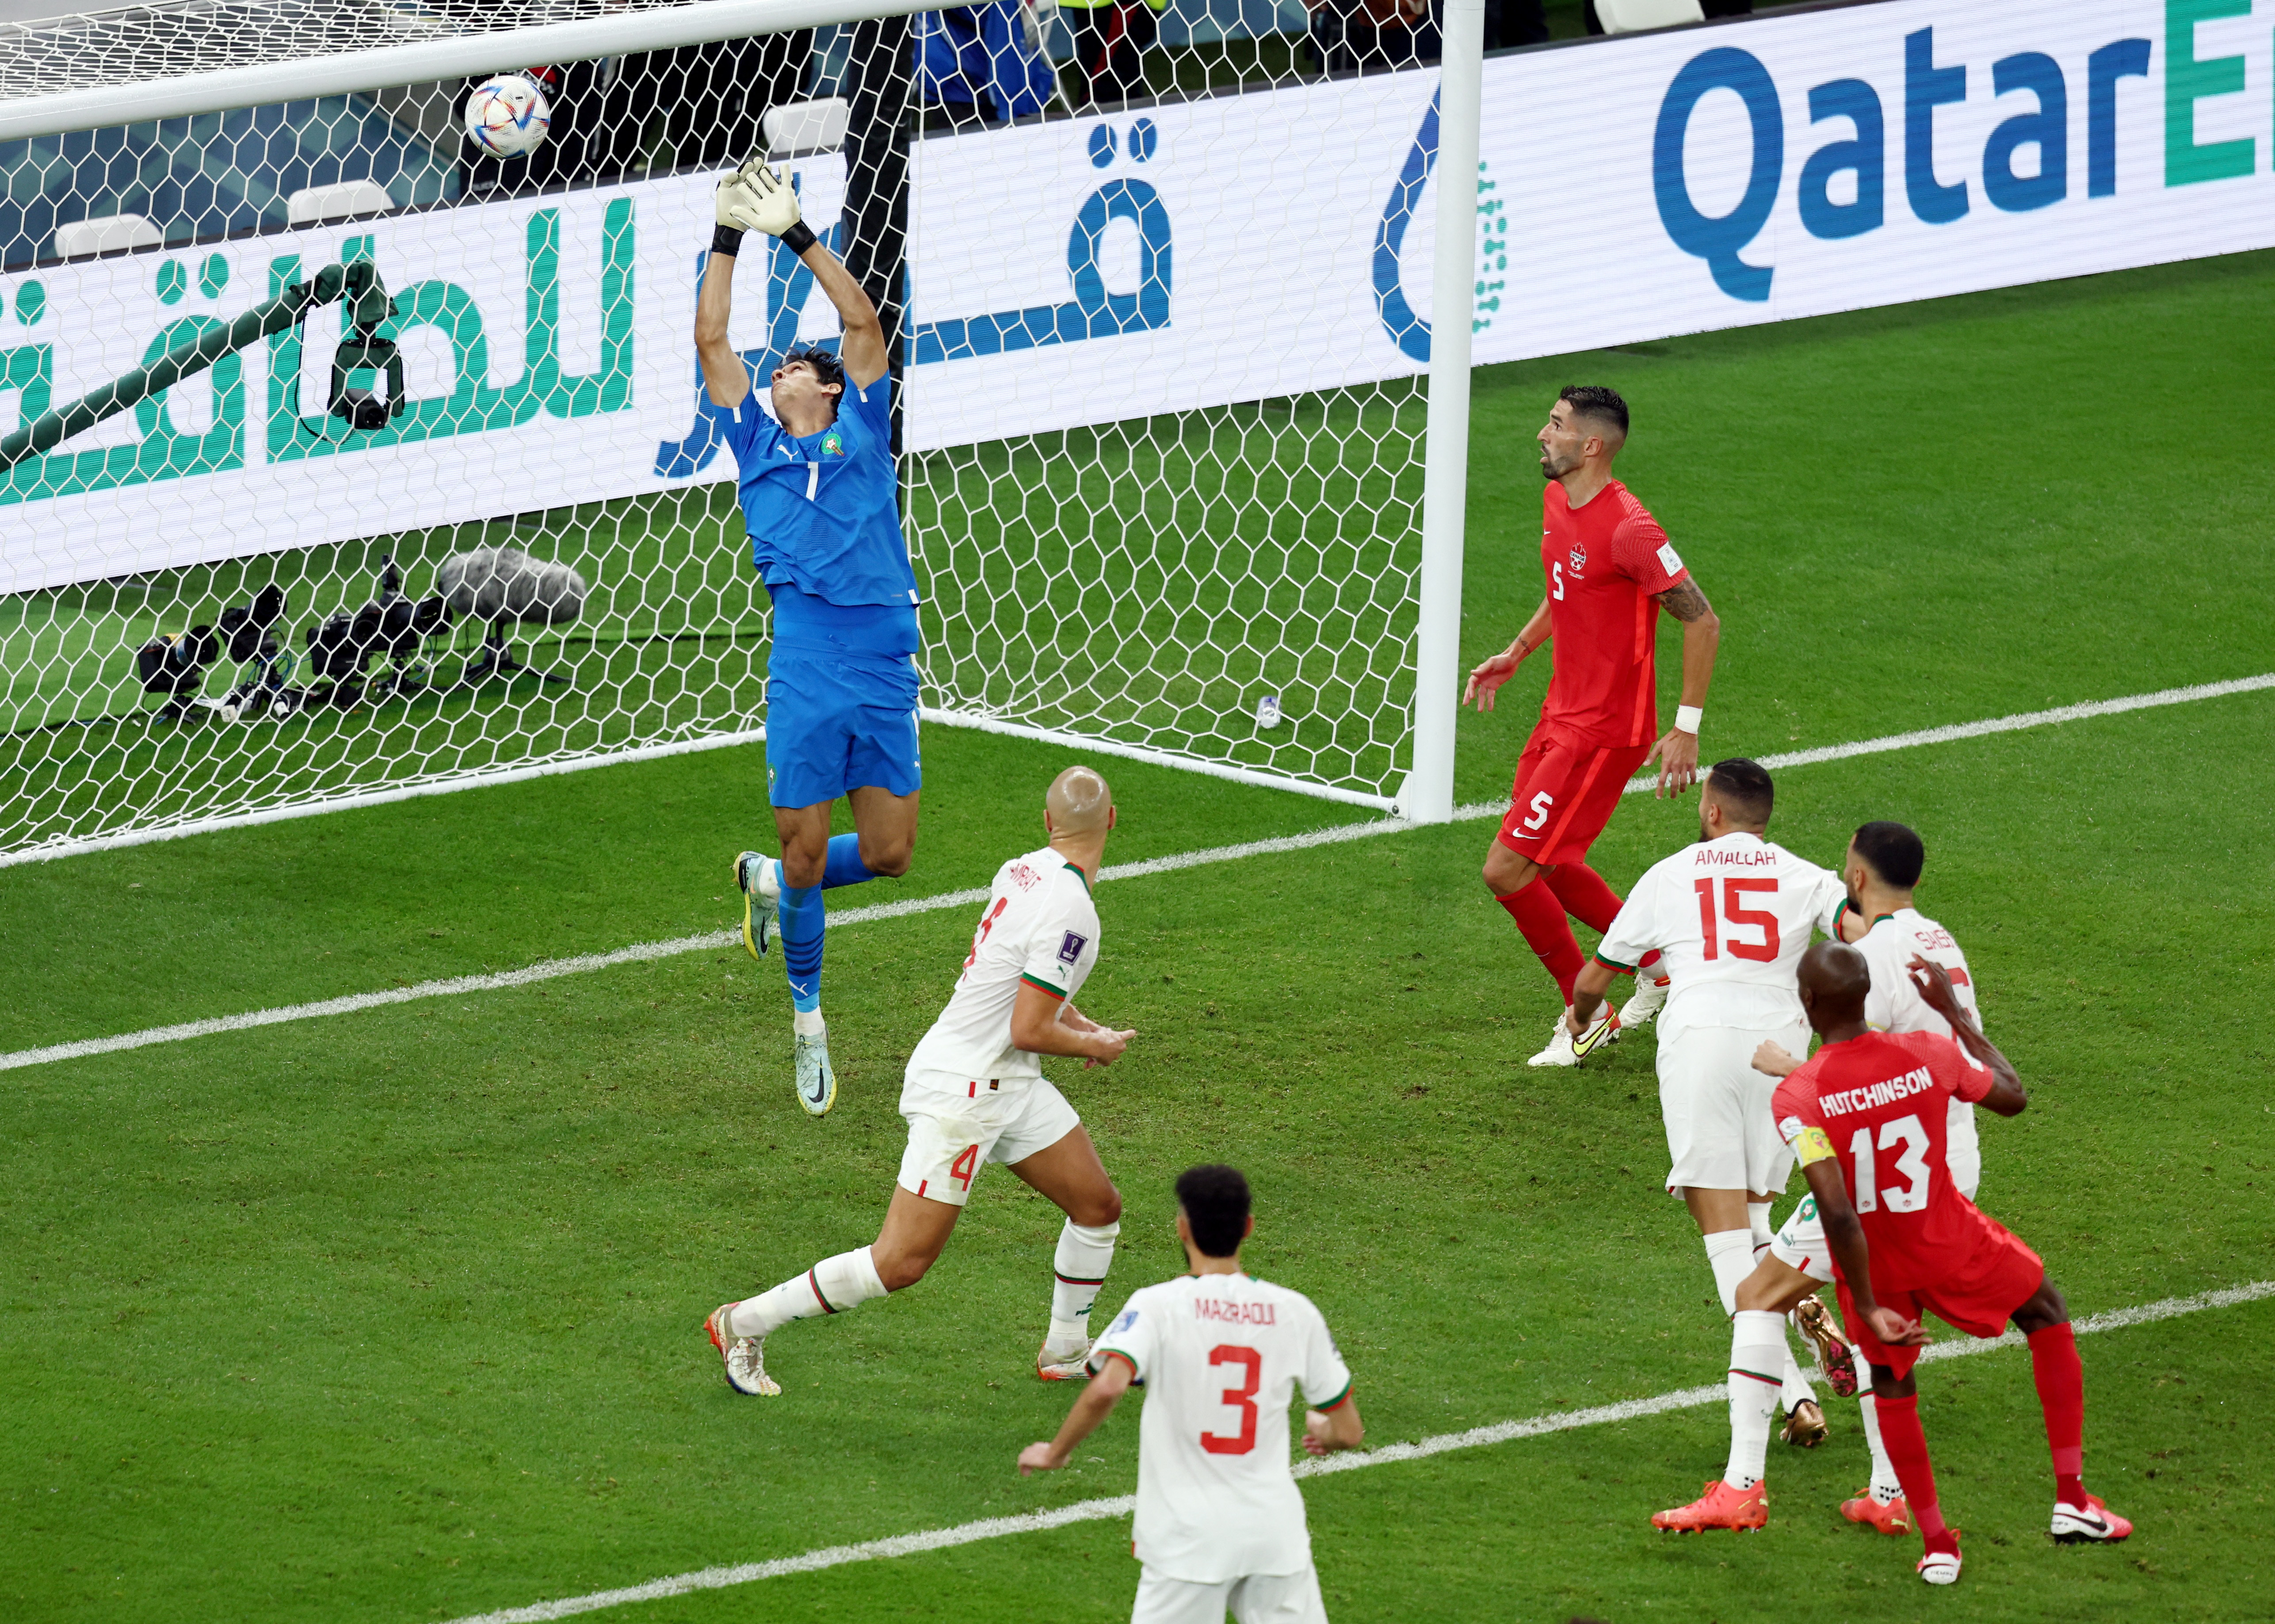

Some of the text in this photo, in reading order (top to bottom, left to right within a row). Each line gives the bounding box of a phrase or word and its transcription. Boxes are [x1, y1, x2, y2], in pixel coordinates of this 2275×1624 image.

[1652, 0, 2275, 302] QatarE
[805, 462, 818, 502] 1
[1570, 551, 1585, 562] CANADA
[1552, 561, 1565, 601] 5
[1523, 791, 1553, 831] 5
[1695, 849, 1777, 866] AMALLAH
[1694, 877, 1780, 963] 15
[1818, 1066, 1933, 1119] HUTCHINSON
[950, 1144, 978, 1192] 4
[1849, 1114, 1931, 1215] 13
[1200, 1344, 1261, 1455] 3
